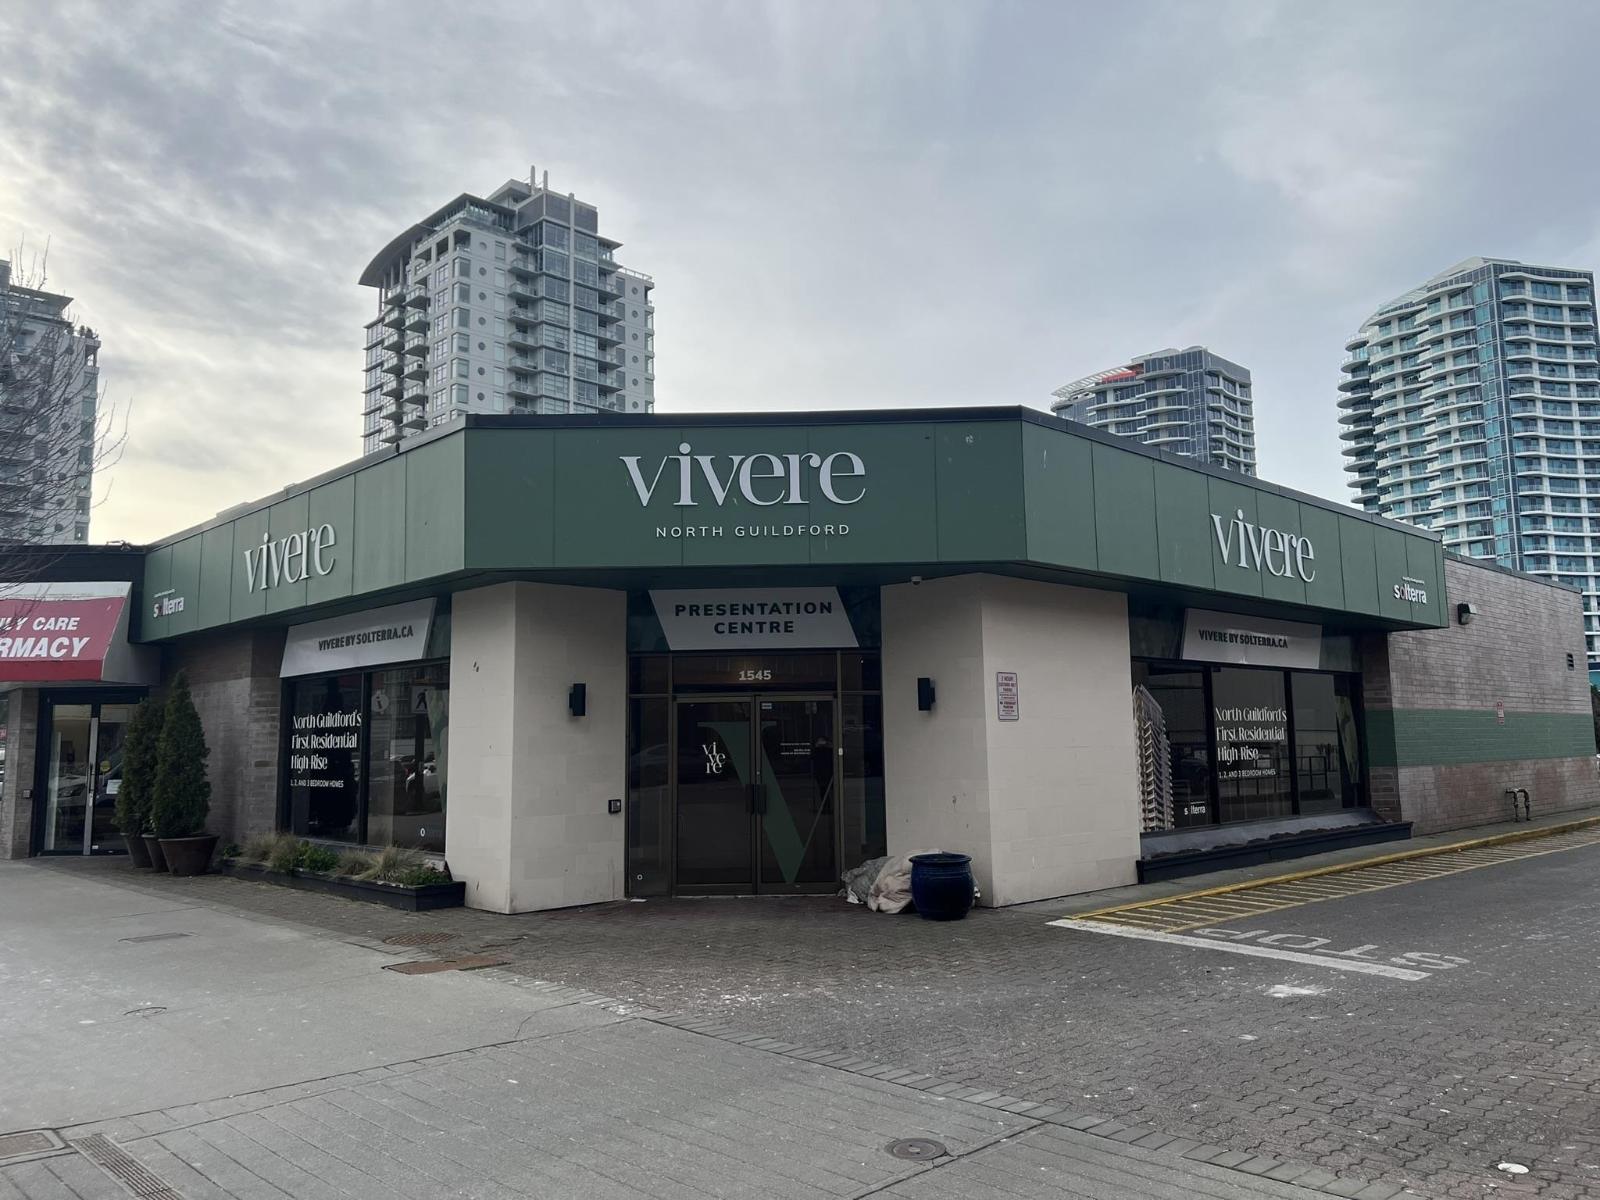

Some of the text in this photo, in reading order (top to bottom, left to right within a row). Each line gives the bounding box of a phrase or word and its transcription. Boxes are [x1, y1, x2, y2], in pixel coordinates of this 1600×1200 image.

[619, 442, 866, 507] vivere
[656, 525, 849, 538] NORTH GUILDFORD
[1210, 509, 1316, 582] vivere
[244, 523, 336, 594] vivere
[153, 597, 184, 618] slterra
[674, 602, 833, 617] PRESENTATION
[32, 617, 80, 631] CARE
[714, 620, 794, 634] CENTRE
[0, 637, 91, 658] RMACY
[738, 670, 772, 681] 1545
[293, 709, 362, 729] North Guildford's
[1215, 707, 1242, 721] North
[291, 731, 358, 749] First Residential
[1216, 726, 1285, 741] First Residential
[1183, 805, 1206, 816] slterra
[1193, 928, 1470, 969] STOP
